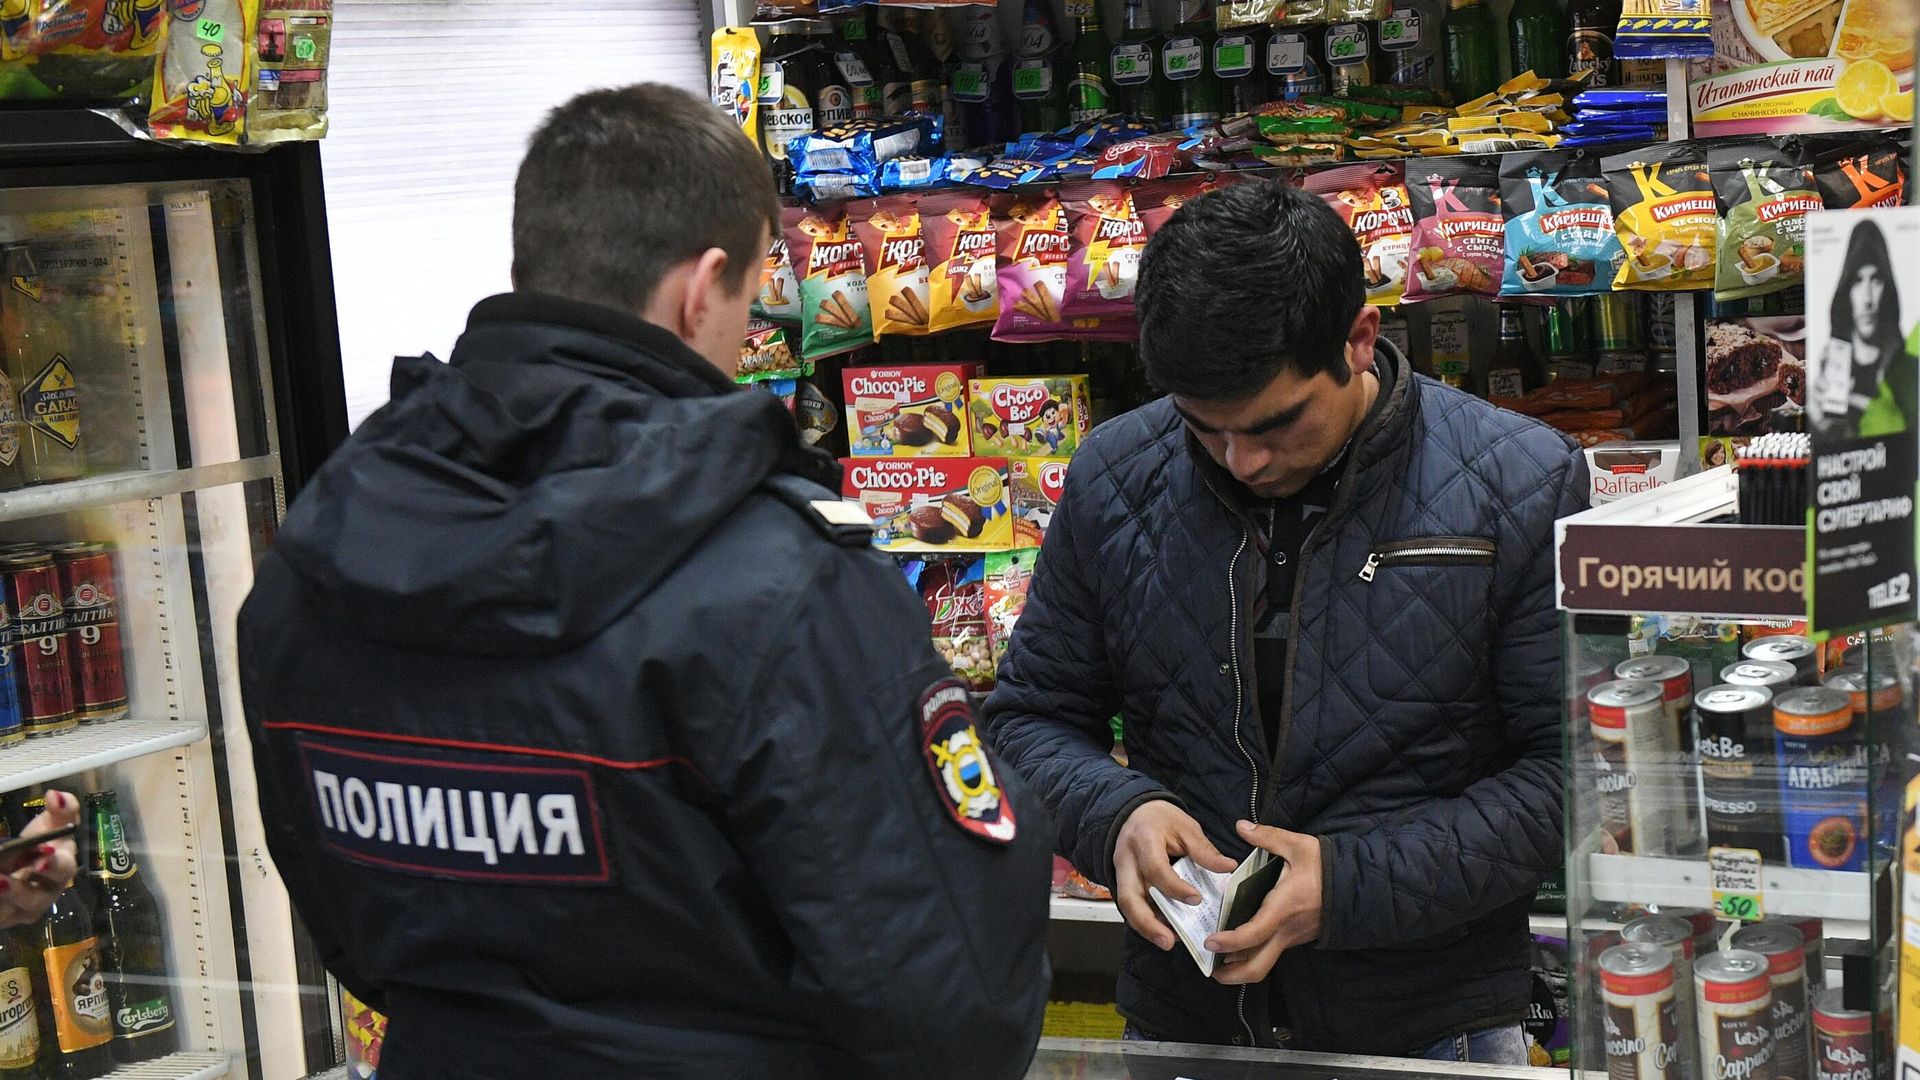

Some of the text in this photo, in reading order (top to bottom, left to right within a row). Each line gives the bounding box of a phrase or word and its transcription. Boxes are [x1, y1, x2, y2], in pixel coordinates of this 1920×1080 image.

[202, 23, 221, 37] 40
[1272, 54, 1288, 67] 50
[1697, 64, 1836, 108] Итальянский пай
[1738, 108, 1779, 118] НАЧИНКОЙ
[1779, 107, 1808, 115] ЛИМОН
[1380, 188, 1402, 210] 3
[1463, 238, 1499, 246] СЕМГА
[948, 265, 969, 275] HEINZ
[885, 462, 913, 470] ORION
[1817, 442, 1887, 479] НАСТРОЙ
[973, 478, 998, 494] Original
[1817, 472, 1862, 507] СВОЙ
[1817, 495, 1914, 534] СУПЕРТАРИФ
[1578, 556, 1732, 598] Горячий
[39, 634, 58, 656] 9
[80, 625, 101, 645] 9
[313, 769, 586, 866] ПОЛИЦИЯ
[110, 814, 130, 871] Carlsberg
[117, 1003, 169, 1028] Carlsberg
